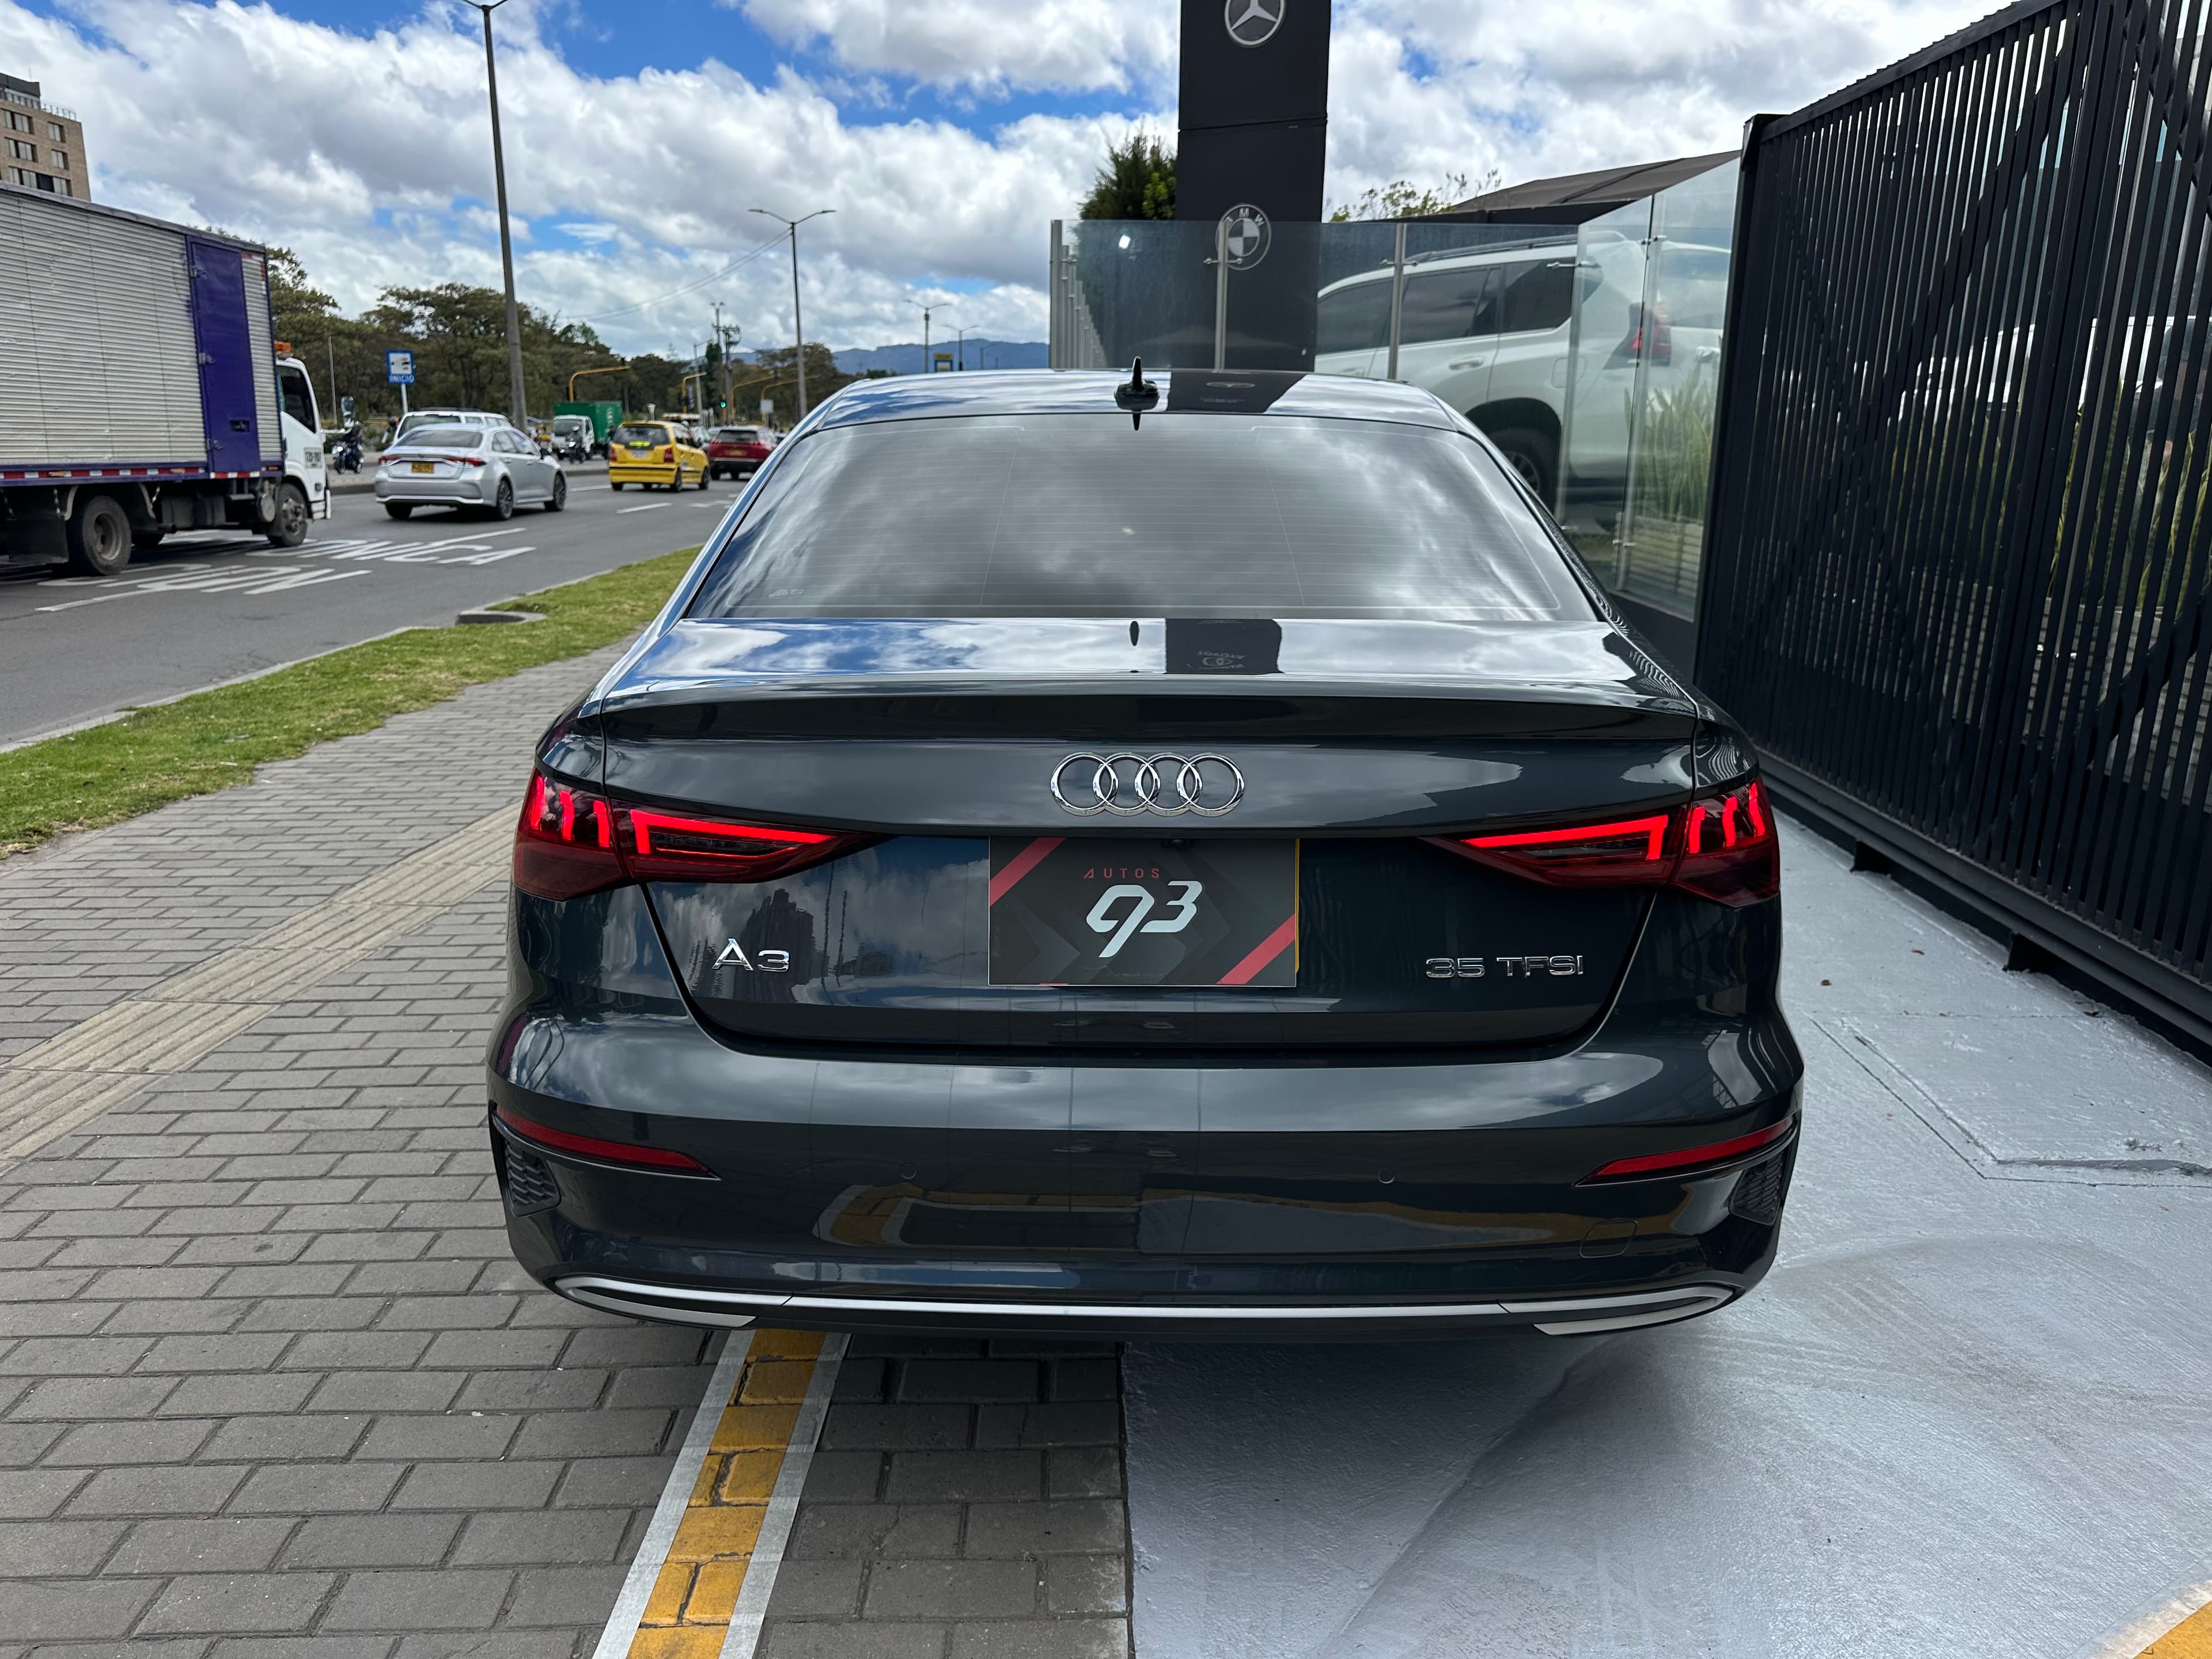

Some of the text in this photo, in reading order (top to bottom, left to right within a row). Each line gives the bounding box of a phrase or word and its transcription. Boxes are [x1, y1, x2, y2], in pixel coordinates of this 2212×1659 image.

[389, 374, 415, 383] INICIO
[1083, 868, 1160, 879] AUTOS
[1086, 881, 1203, 958] 93
[711, 938, 790, 972] A3
[1426, 955, 1584, 978] 35 TFSI
